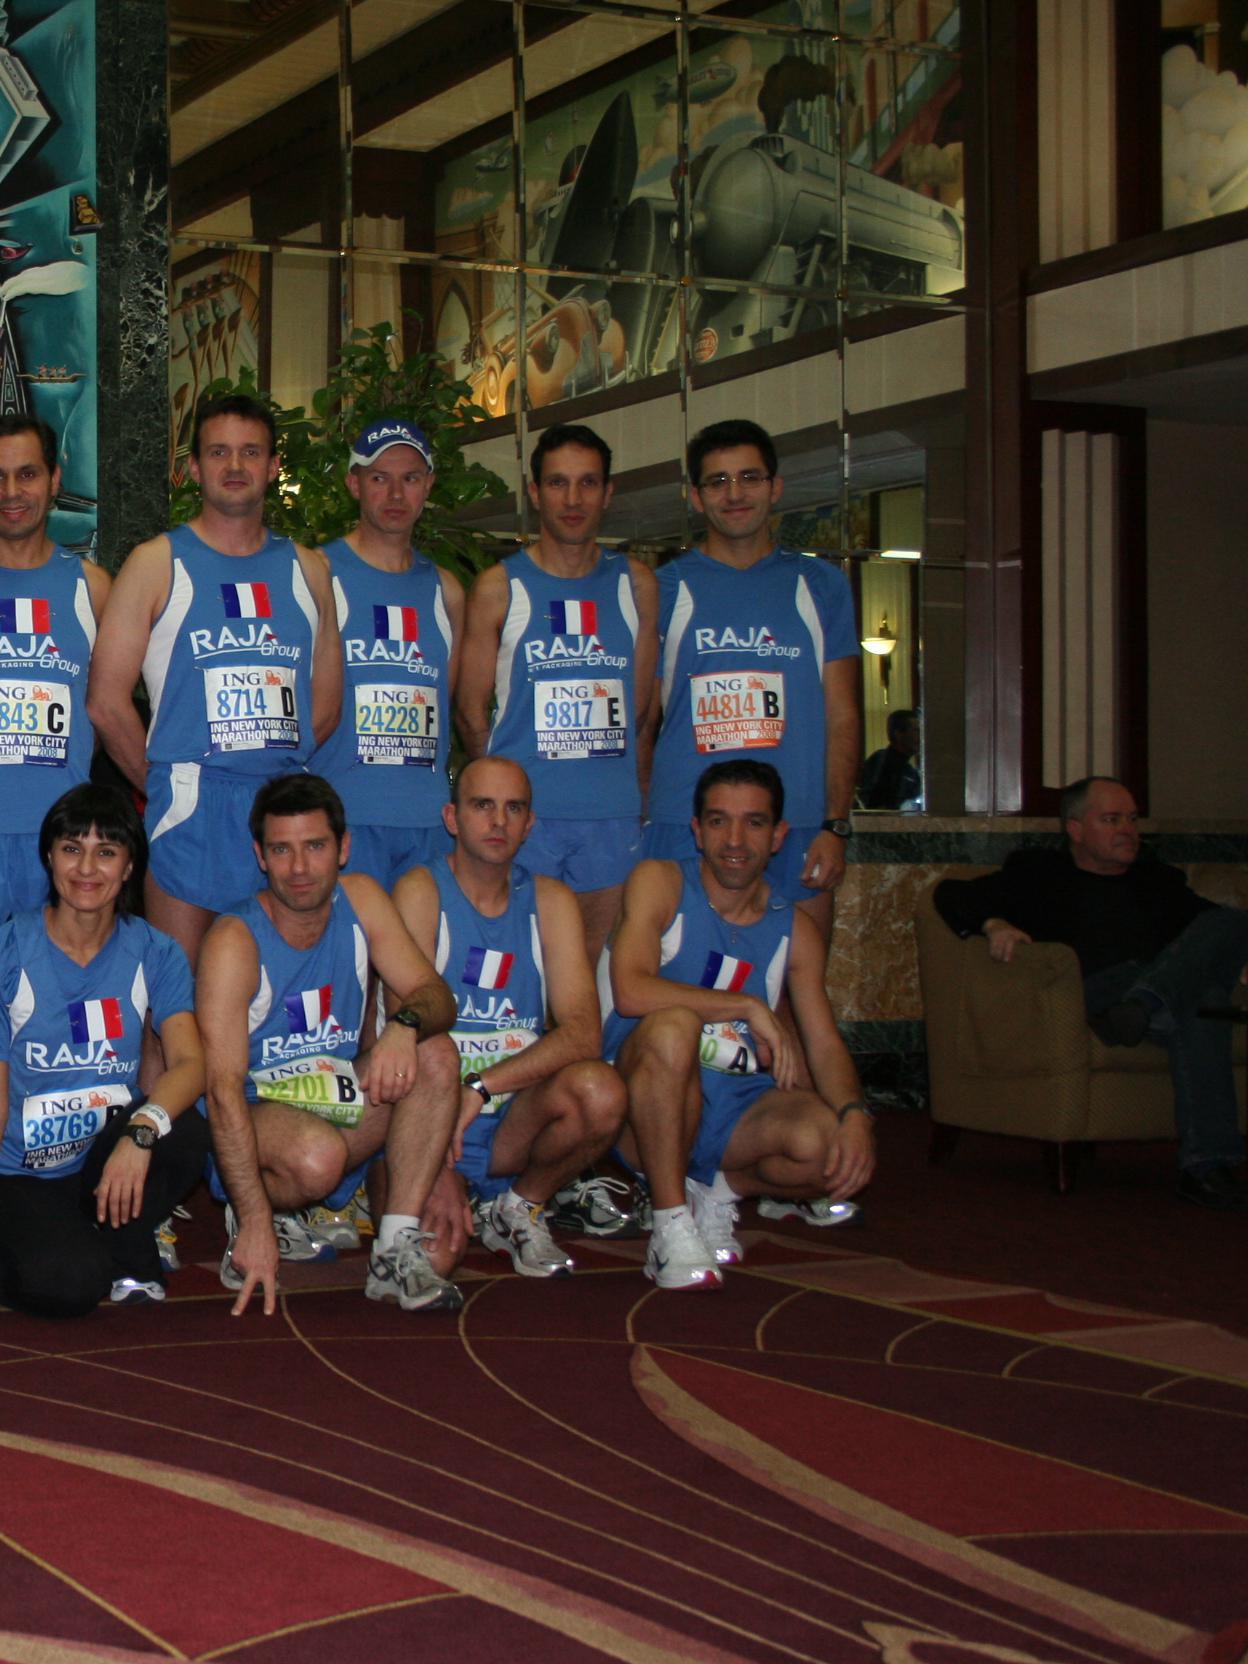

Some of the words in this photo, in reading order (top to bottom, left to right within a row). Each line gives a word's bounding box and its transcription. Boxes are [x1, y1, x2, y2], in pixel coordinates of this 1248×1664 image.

[368, 425, 410, 444] RAJA
[189, 624, 278, 655] RAJA
[695, 627, 775, 649] RAJA
[345, 639, 424, 663] RAJA
[524, 635, 606, 663] RAJA
[757, 644, 800, 660] Group
[40, 654, 80, 677] Group
[587, 652, 627, 669] Group
[222, 673, 261, 686] ING
[705, 679, 742, 693] ING
[373, 691, 408, 704] ING
[551, 685, 588, 699] ING
[217, 688, 267, 718] 8714
[281, 686, 294, 717] D
[697, 692, 756, 721] 44814
[763, 691, 779, 718] B
[47, 703, 64, 734] C
[359, 705, 419, 733] 24228
[425, 706, 434, 735] F
[544, 701, 592, 728] 9817
[607, 698, 620, 727] E
[211, 723, 229, 733] ING
[231, 721, 255, 731] NEW
[258, 720, 282, 730] YORK
[283, 721, 298, 731] CITY
[696, 726, 712, 735] ING
[713, 724, 735, 733] NEW
[737, 722, 762, 730] YORK
[764, 721, 783, 729] CITY
[17, 736, 43, 746] YORK
[46, 738, 66, 748] CITY
[212, 731, 269, 744] MARATHON
[358, 736, 376, 745] ING
[377, 736, 400, 746] NEW
[402, 737, 423, 747] YORK
[423, 739, 436, 748] CITY
[537, 732, 555, 741] ING
[557, 732, 581, 740] NEW
[582, 731, 605, 740] YORK
[607, 730, 624, 739] CITY
[697, 731, 748, 744] MARATHON
[358, 746, 410, 756] MARATHON
[538, 741, 592, 751] MARATHON
[453, 993, 516, 1020] AJA
[262, 1015, 343, 1057] RAJA
[26, 1040, 118, 1067] RAJA
[280, 1046, 321, 1059] ACKAGING
[460, 1040, 499, 1053] ING
[728, 1046, 748, 1072] A
[269, 1063, 310, 1080] ING
[336, 1075, 356, 1102] B
[41, 1097, 83, 1115] ING
[335, 1106, 358, 1115] CITY
[26, 1111, 97, 1148] 38769
[48, 1143, 72, 1155] NEW
